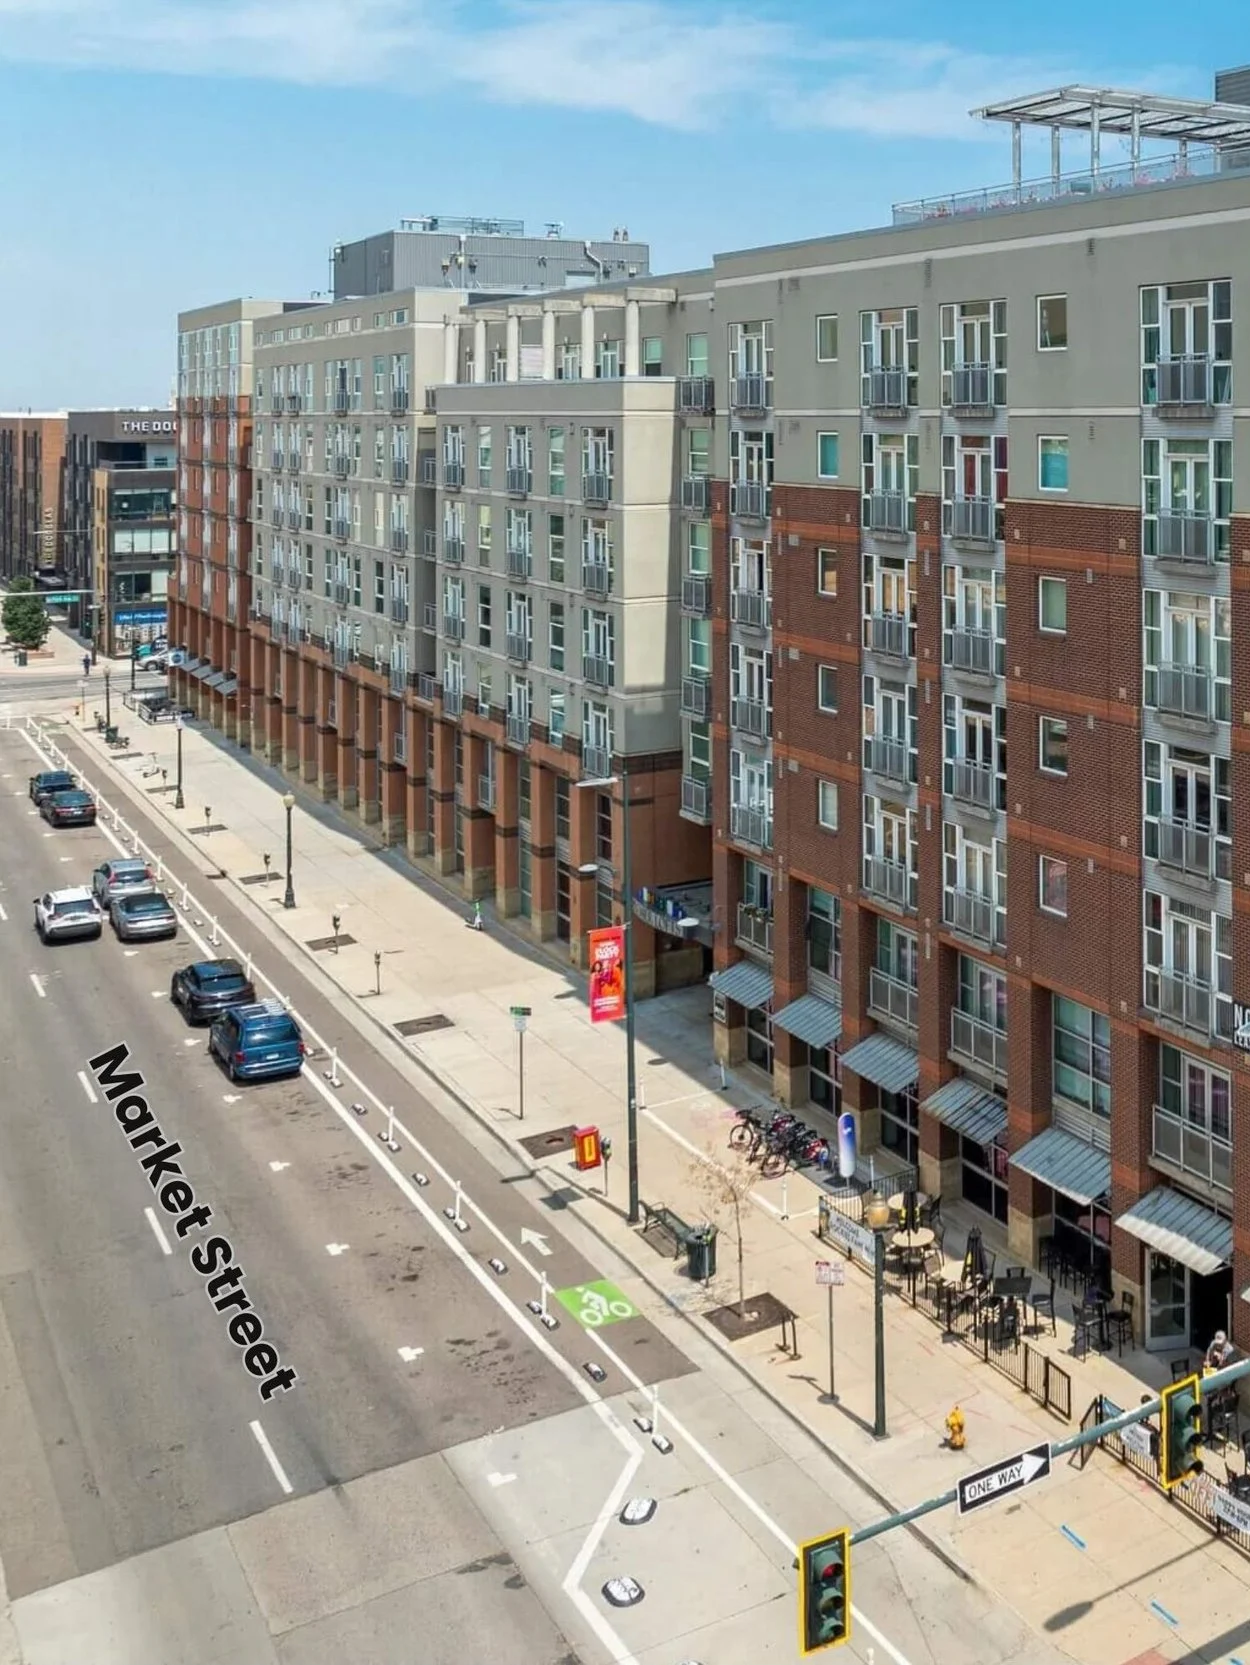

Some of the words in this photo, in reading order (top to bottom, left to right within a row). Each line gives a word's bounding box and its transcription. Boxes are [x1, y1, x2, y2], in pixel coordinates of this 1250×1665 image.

[122, 421, 149, 432] THE
[968, 1477, 994, 1500] ONE
[997, 1463, 1023, 1486] WAY
